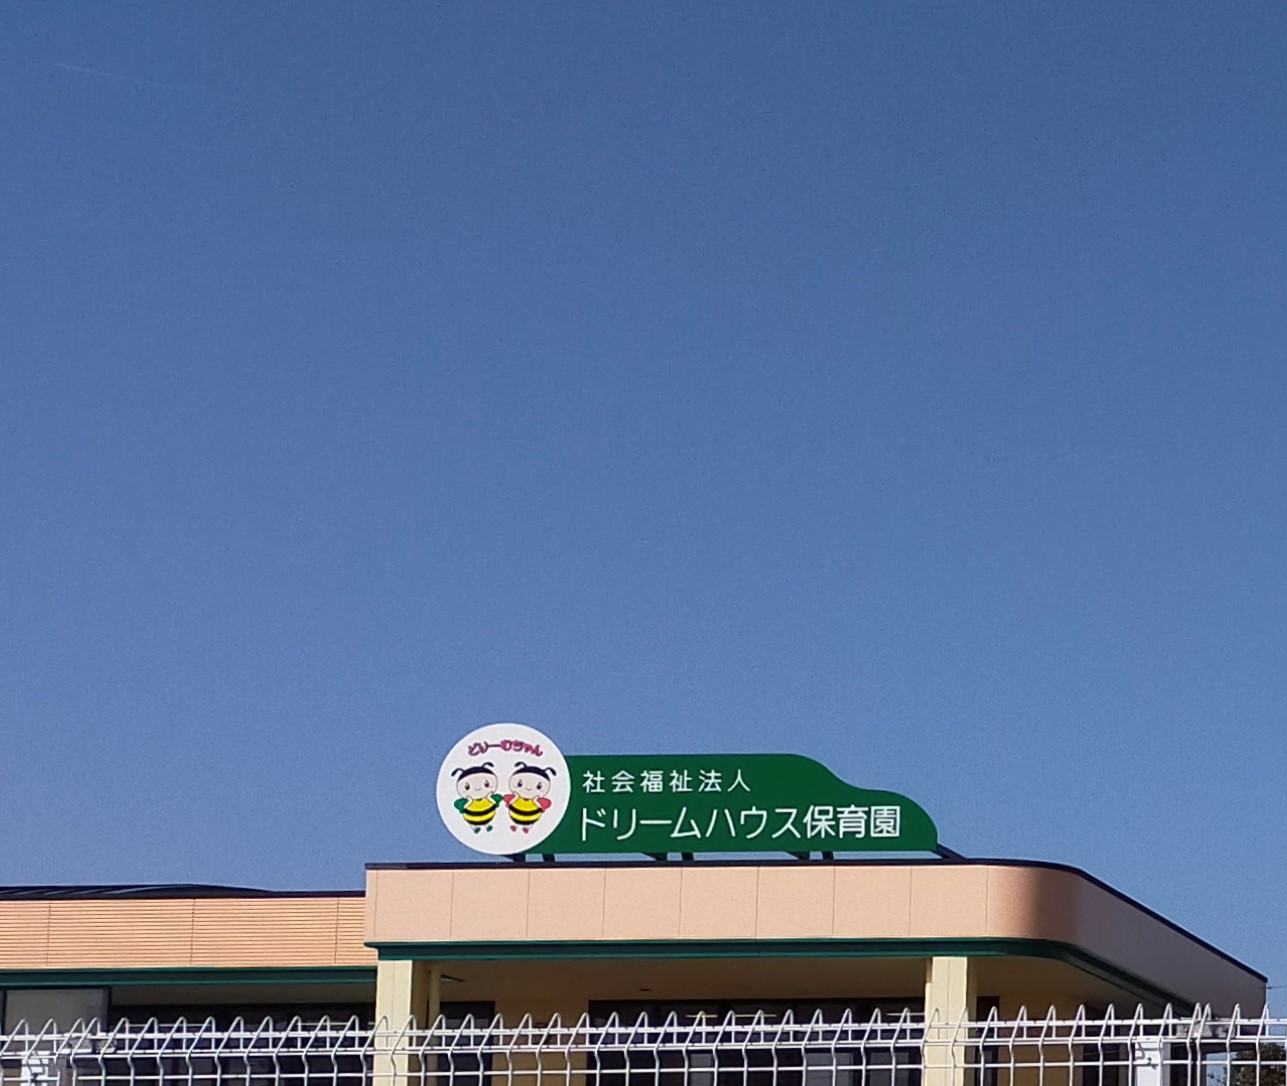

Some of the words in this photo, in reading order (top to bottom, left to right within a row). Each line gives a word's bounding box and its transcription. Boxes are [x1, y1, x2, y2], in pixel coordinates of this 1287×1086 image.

[582, 769, 751, 794] 社会福祉法人
[581, 804, 901, 842] ドリームハウス保育園
